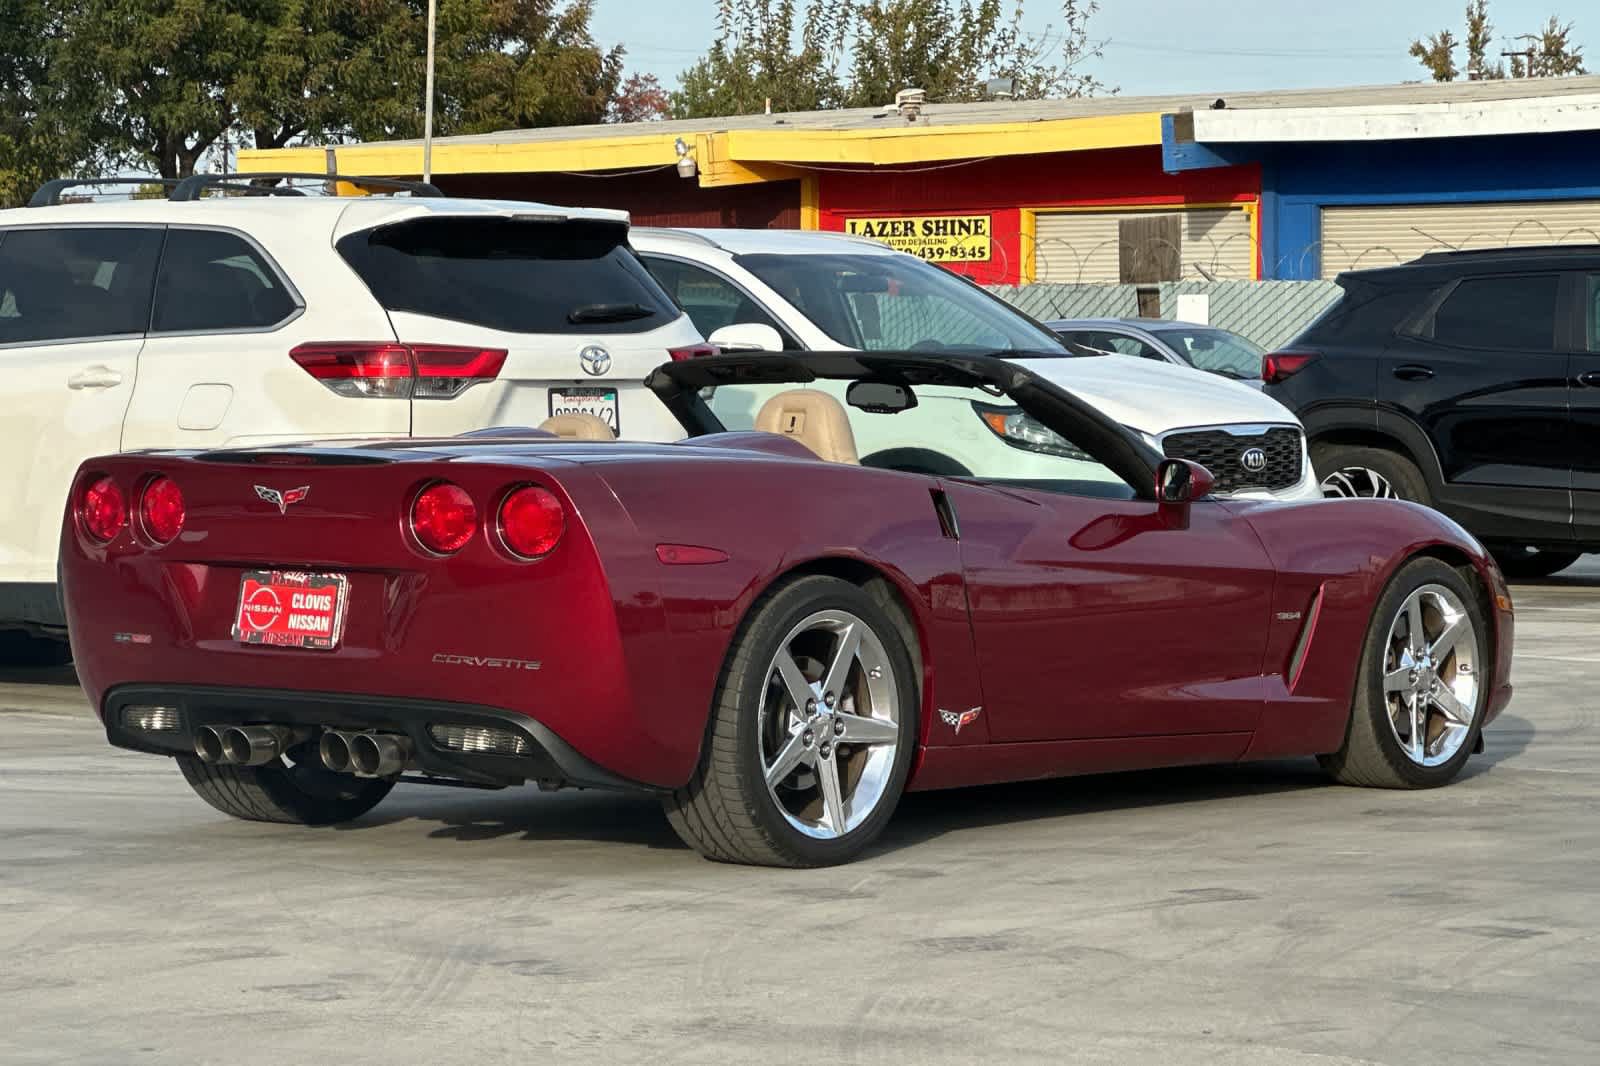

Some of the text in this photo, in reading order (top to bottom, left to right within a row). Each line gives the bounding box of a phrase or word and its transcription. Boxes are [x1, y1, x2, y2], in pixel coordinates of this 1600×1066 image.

[849, 219, 986, 237] LAZER SHINE
[887, 238, 948, 247] AUTO DETAILING
[894, 246, 986, 260] -439-8345
[1247, 452, 1265, 467] KIA
[244, 603, 282, 614] NISSAN
[291, 593, 331, 611] CLOVIS
[288, 614, 329, 632] NISSAN
[432, 654, 541, 669] CORVETTE
